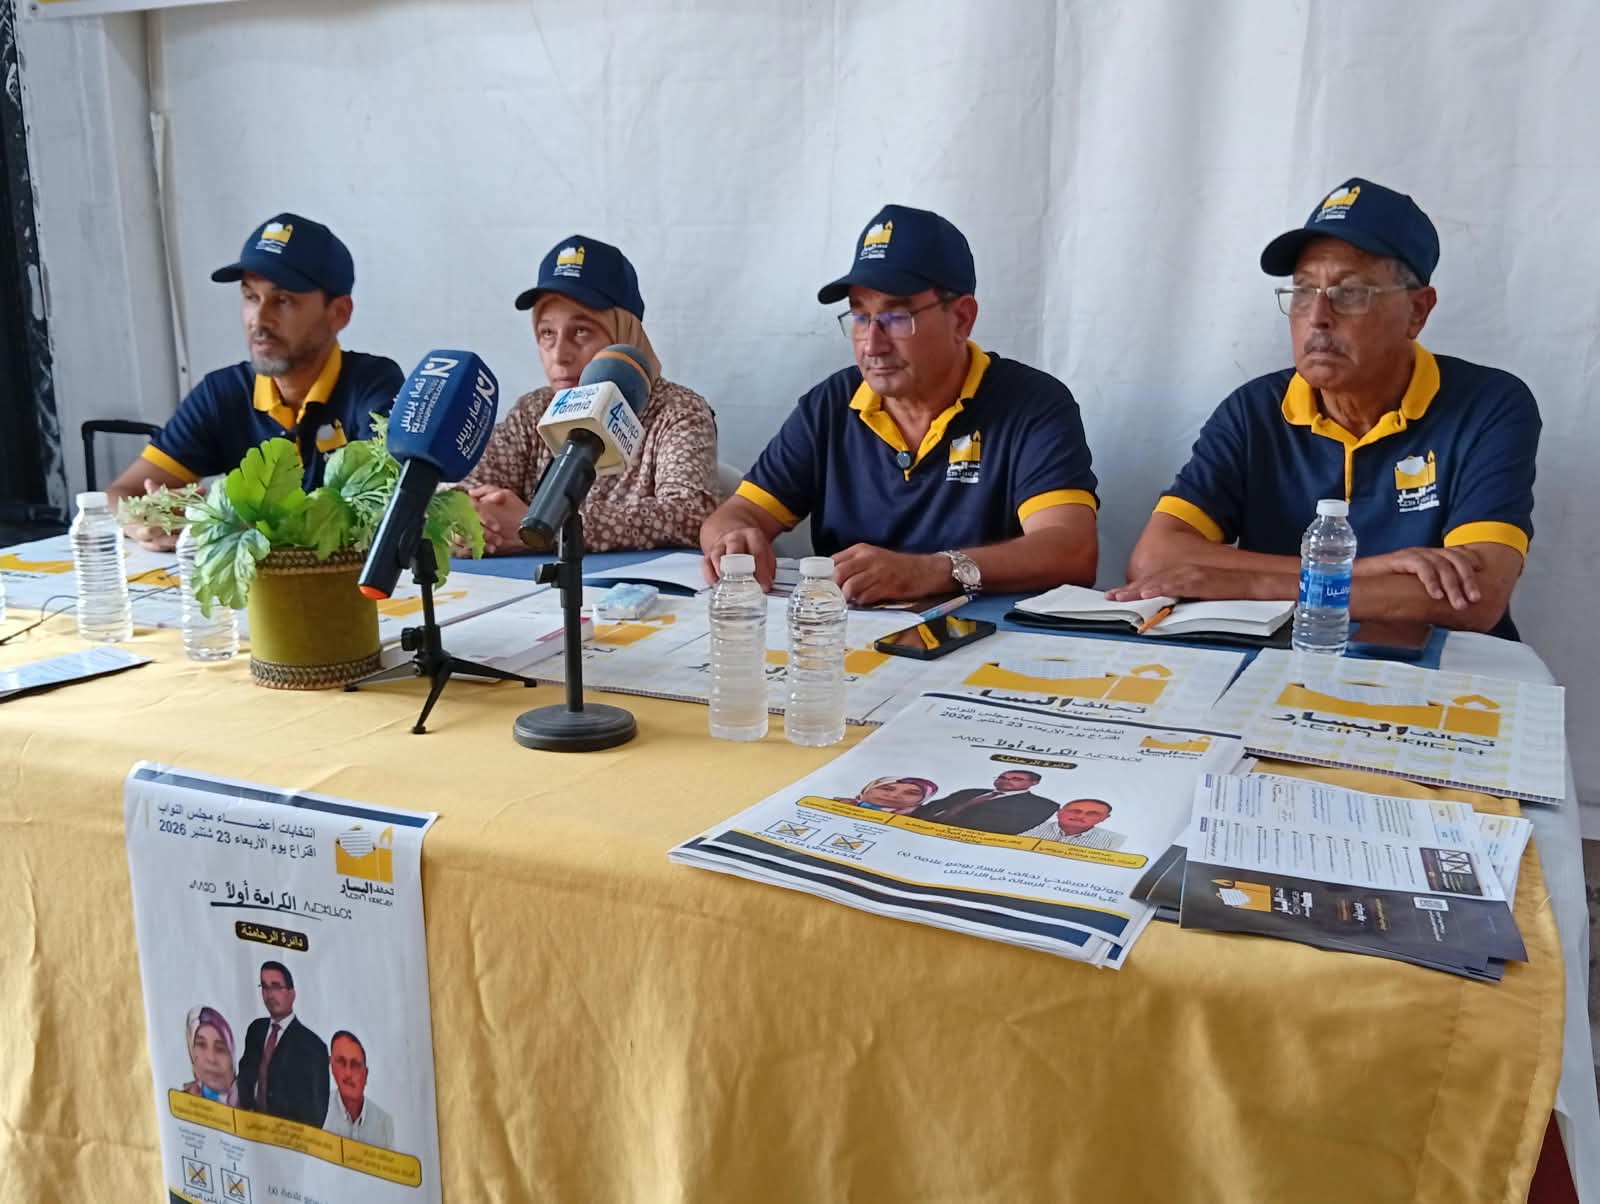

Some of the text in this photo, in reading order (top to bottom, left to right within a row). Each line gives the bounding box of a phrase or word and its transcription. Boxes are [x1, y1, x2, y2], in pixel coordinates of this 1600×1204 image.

[940, 711, 972, 721] 2026
[1007, 719, 1023, 728] 23
[1409, 730, 1495, 748] تحالف
[1026, 744, 1078, 756] الكرامة
[158, 802, 184, 816] النواب
[187, 807, 214, 823] مجلس
[159, 818, 187, 837] 2026
[278, 823, 317, 840] انتخابات
[216, 829, 232, 845] 23
[271, 843, 287, 855] يوم
[290, 844, 317, 860] اقتراع
[914, 855, 942, 865] علامة
[975, 865, 1006, 873] اليسار
[1008, 871, 1041, 880] تحالف
[1008, 878, 1046, 888] الرسالة
[1090, 884, 1125, 896] صوتوا
[253, 889, 297, 911] الكرامة
[281, 931, 304, 948] دائرة
